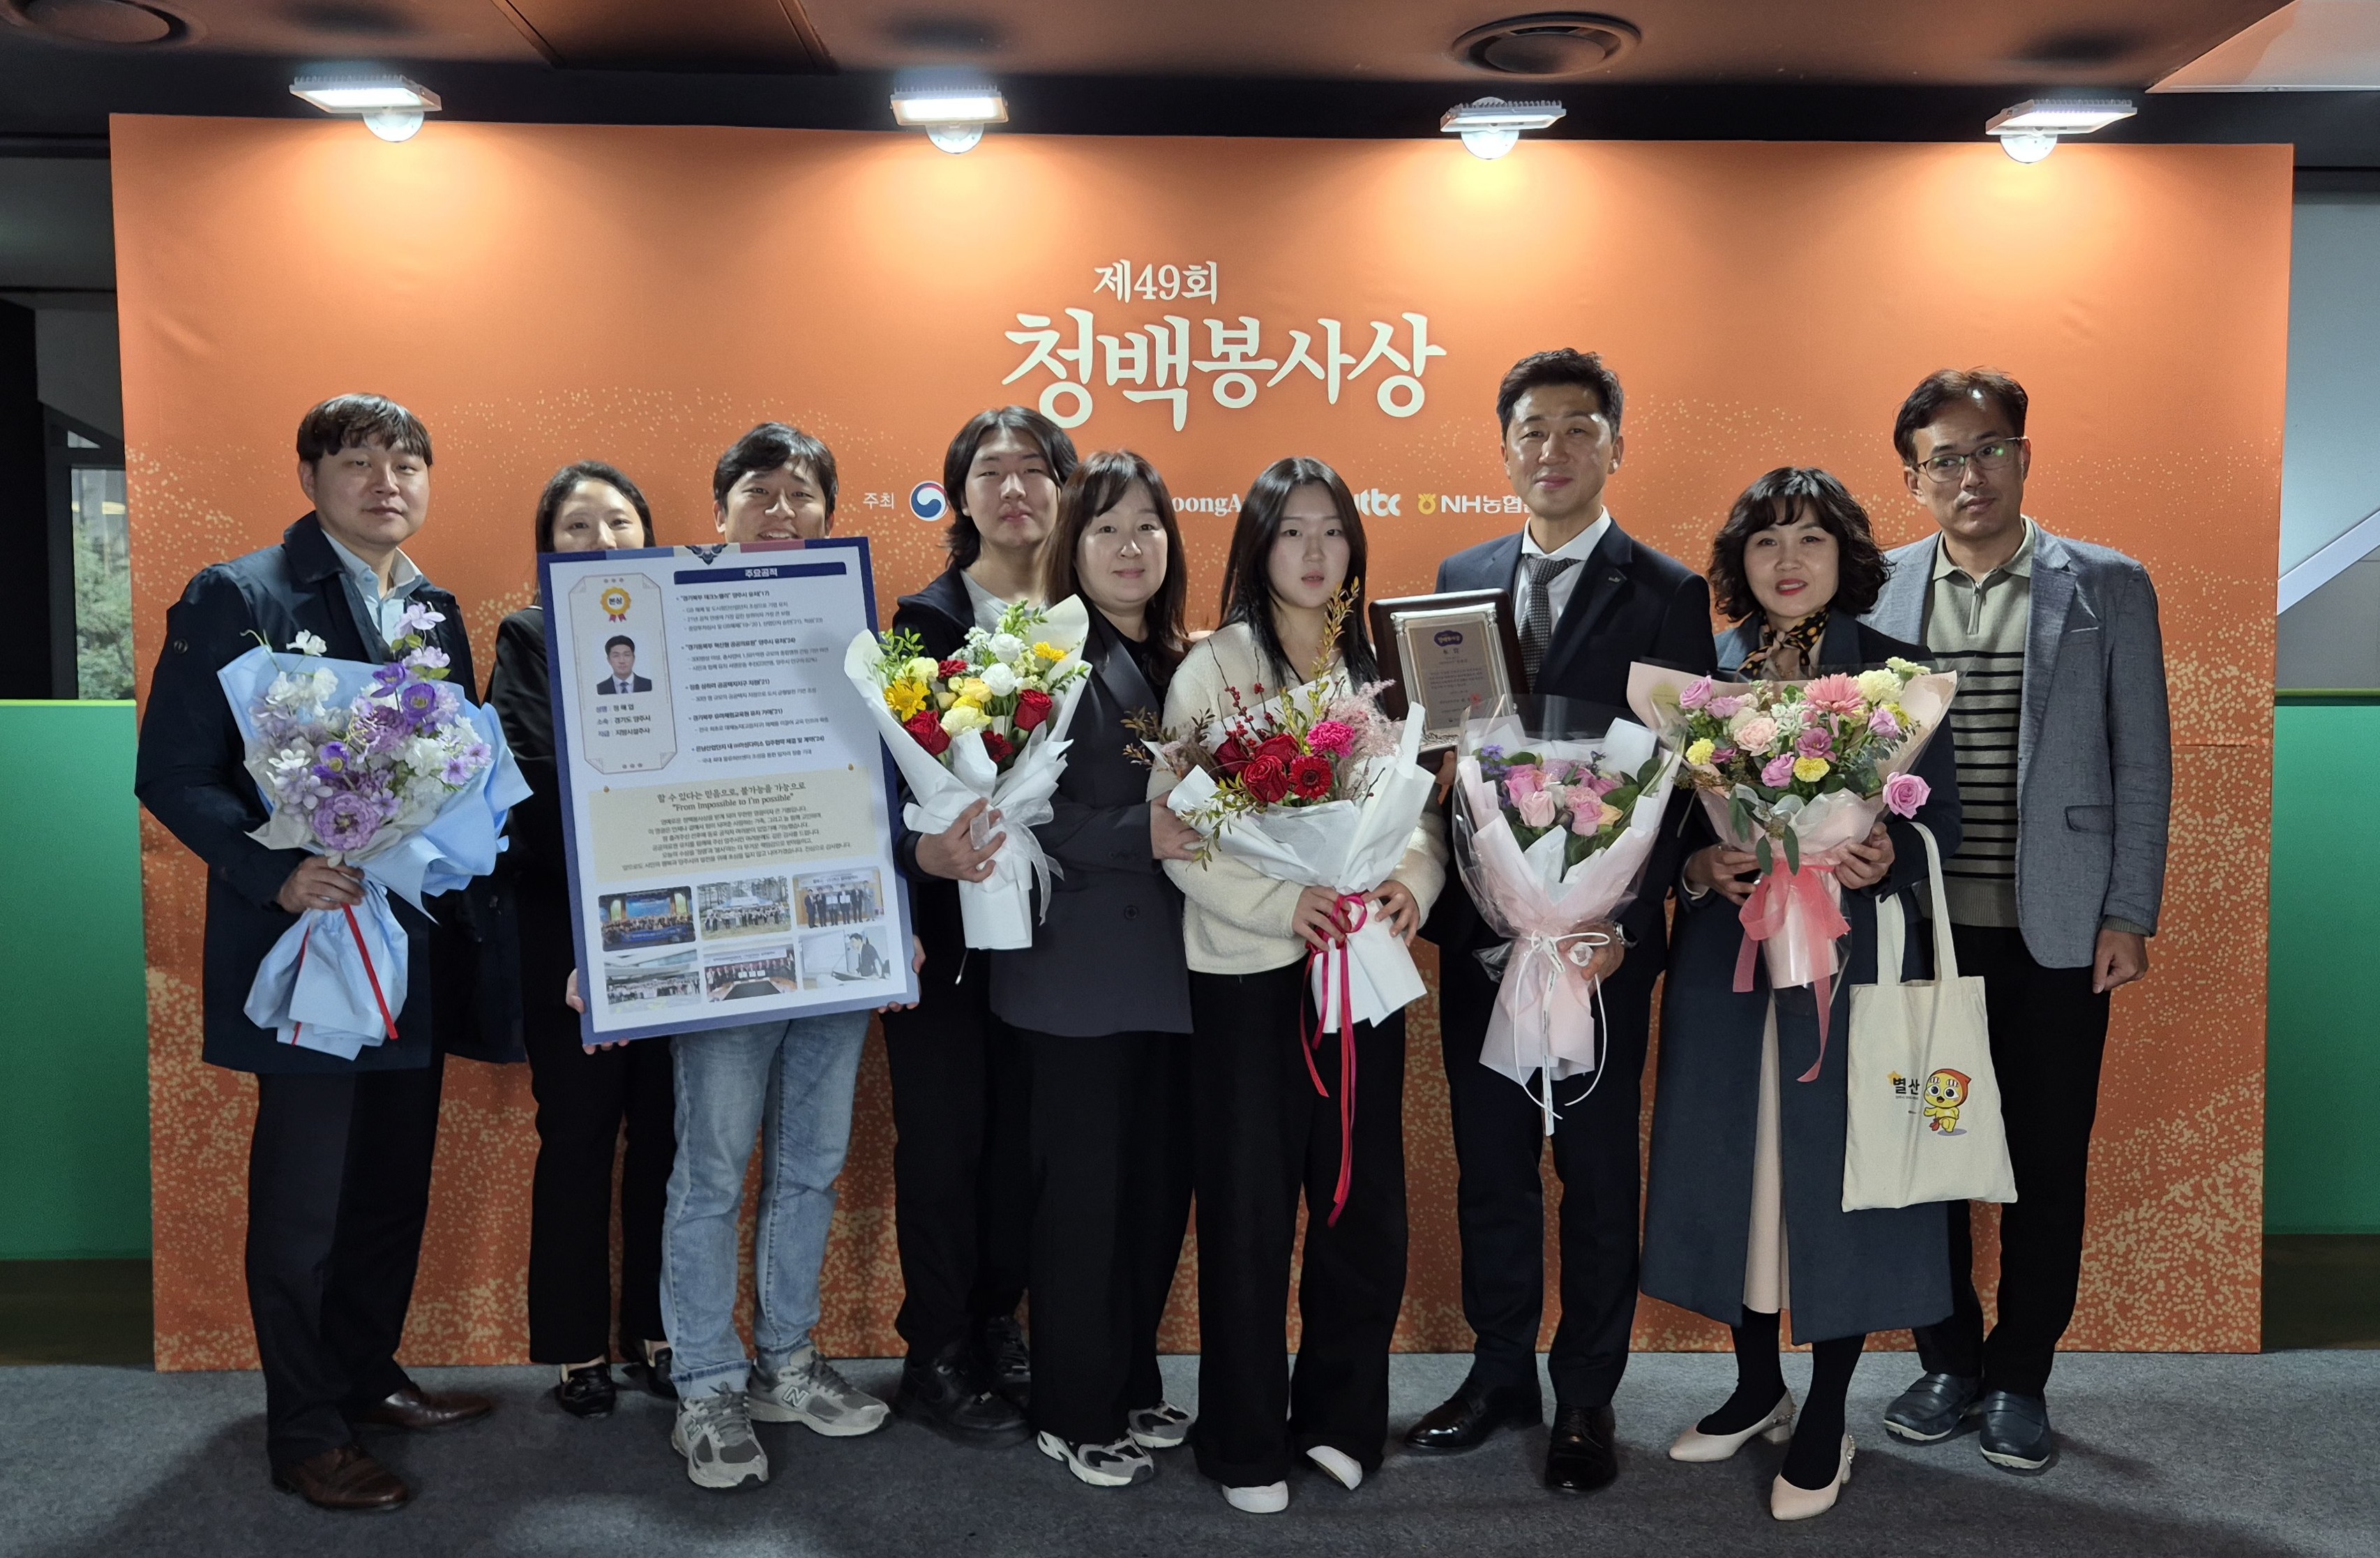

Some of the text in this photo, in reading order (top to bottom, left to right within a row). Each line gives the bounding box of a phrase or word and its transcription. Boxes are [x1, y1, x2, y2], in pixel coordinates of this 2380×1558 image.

[1093, 259, 1217, 305] 제49회
[1002, 308, 1447, 432] 청백봉사상
[863, 492, 894, 509] 주최
[1172, 493, 1242, 517] oongA
[745, 568, 778, 578] 주요공적
[657, 794, 666, 802] 할
[668, 793, 677, 802] 수
[679, 791, 702, 801] 있다는
[698, 799, 736, 809] Impossible
[783, 1386, 808, 1407] N
